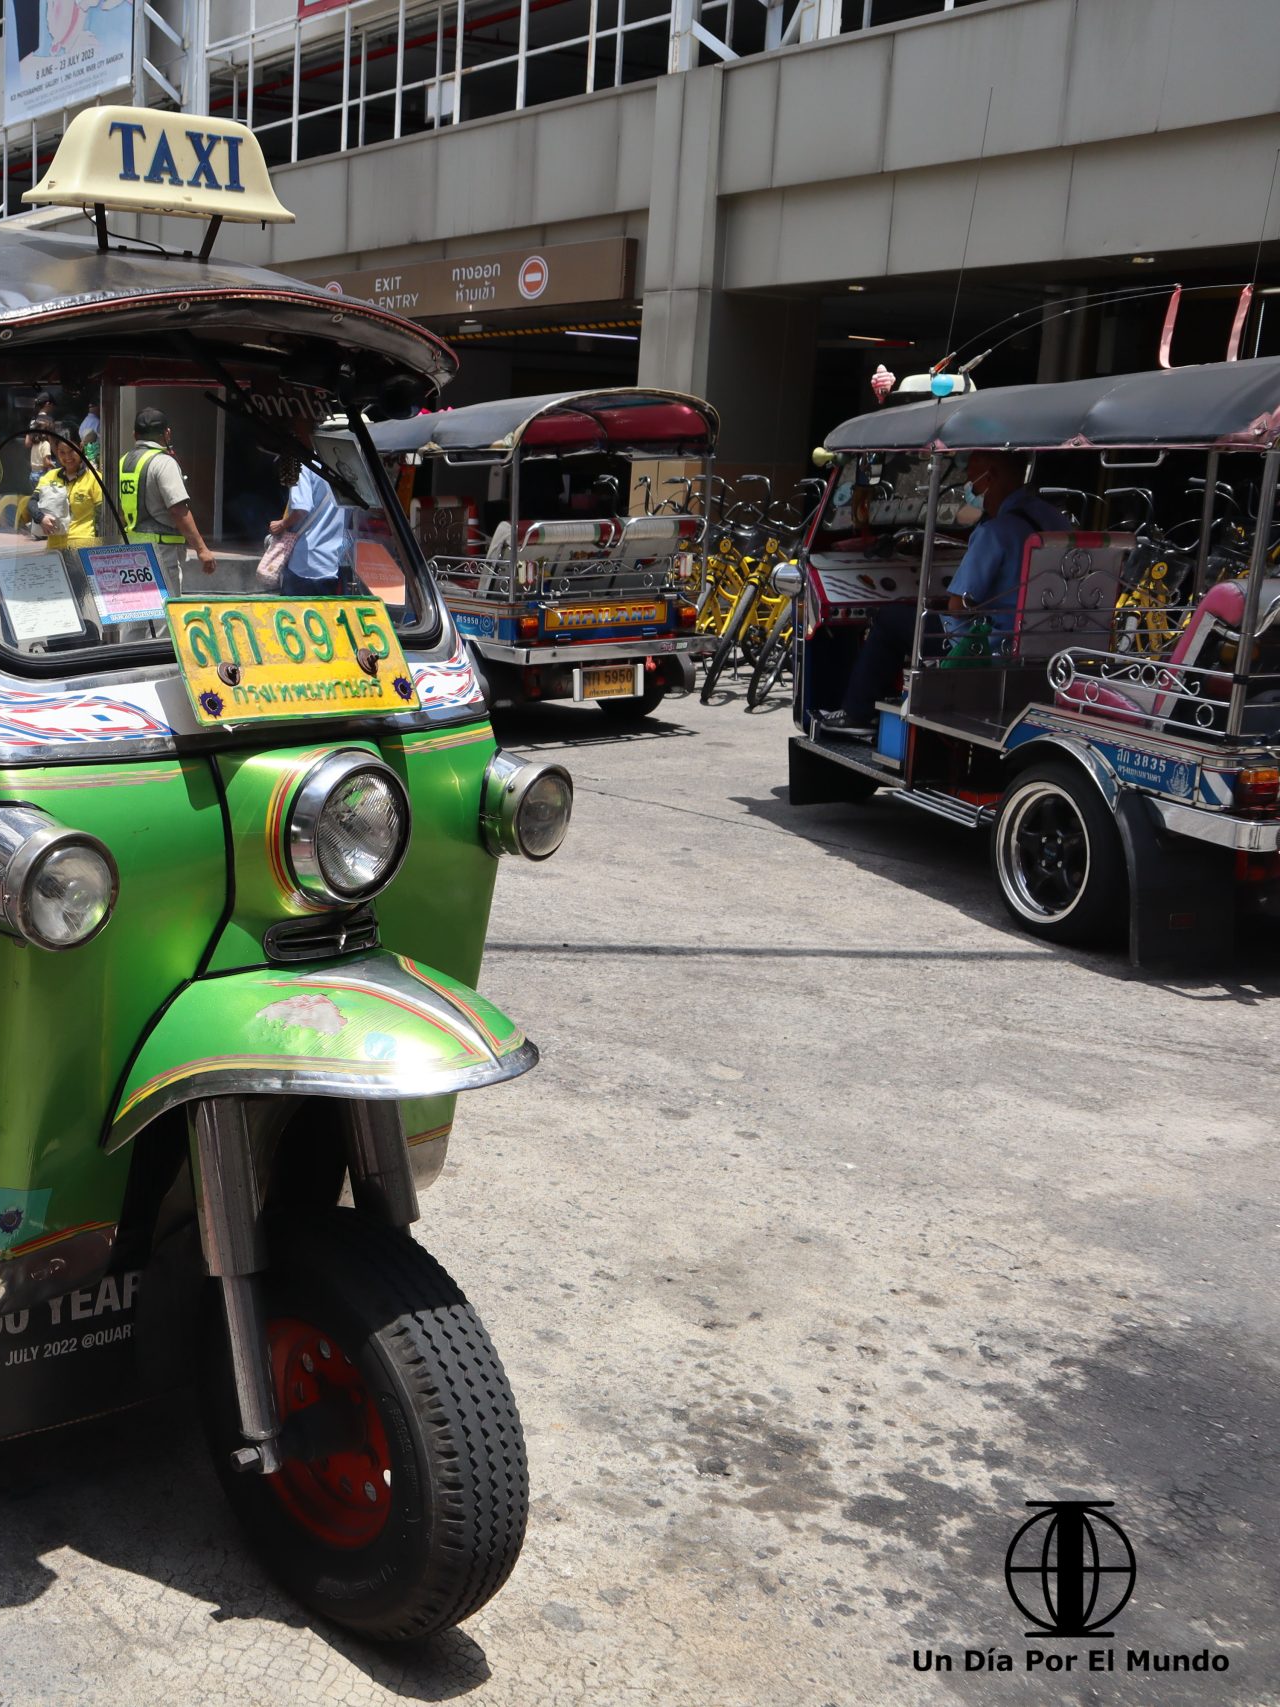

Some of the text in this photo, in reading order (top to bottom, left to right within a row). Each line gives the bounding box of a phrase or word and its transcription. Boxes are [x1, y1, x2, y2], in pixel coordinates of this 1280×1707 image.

[41, 64, 53, 78] JUNE
[60, 60, 66, 70] 23
[67, 53, 79, 67] JULY
[81, 48, 94, 62] 2023
[109, 122, 245, 192] TAXI
[452, 262, 501, 282] ทางออก
[375, 276, 402, 292] EXIT
[455, 280, 496, 303] ห้ามเข้า
[379, 292, 419, 310] ENTRY
[119, 567, 153, 585] 2566
[558, 604, 658, 626] THAILAND
[184, 605, 390, 668] สก 6915
[604, 668, 633, 684] 5950
[233, 679, 382, 709] กรุงเทพมหานคร
[1134, 753, 1167, 773] 3835
[5, 1345, 40, 1366] JULY
[44, 1338, 78, 1358] 2022
